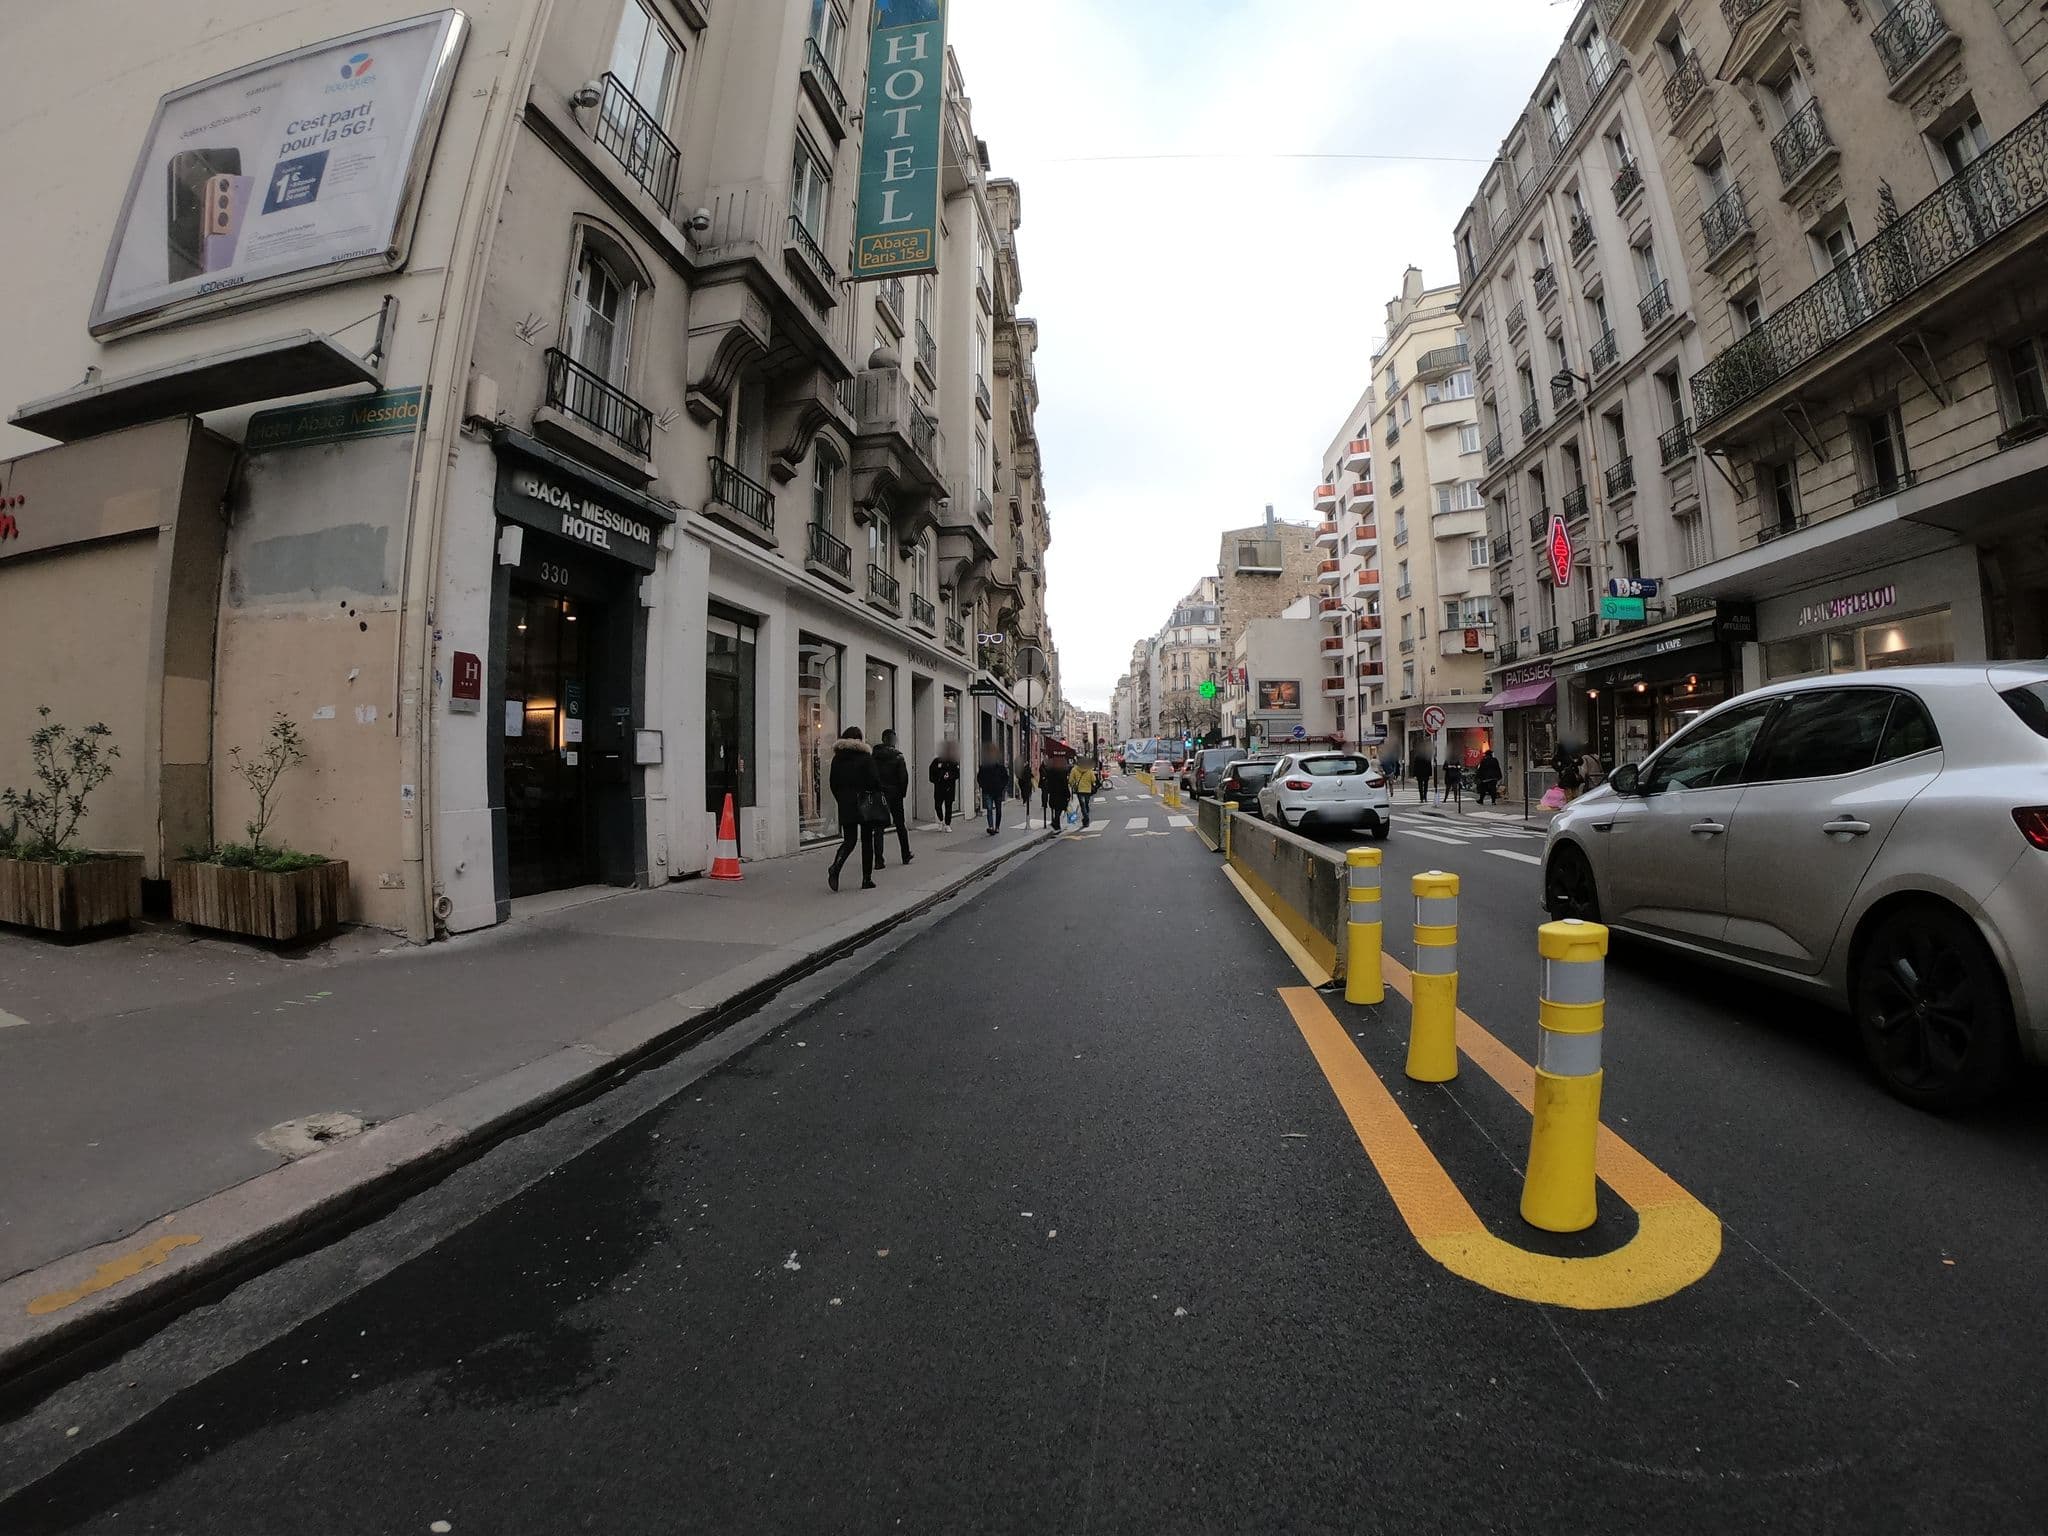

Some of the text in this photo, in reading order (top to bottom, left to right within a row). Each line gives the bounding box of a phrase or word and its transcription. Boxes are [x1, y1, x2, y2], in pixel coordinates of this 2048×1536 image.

[286, 113, 328, 135] C'est
[328, 100, 374, 128] parti
[879, 31, 930, 225] HOTEL
[279, 133, 321, 159] pour
[322, 129, 337, 143] la
[331, 247, 378, 261] summum
[871, 236, 919, 252] Abaca
[862, 247, 924, 265] Paris 15e
[197, 275, 245, 294] JCDecaux
[561, 514, 611, 550] HOTEL
[1554, 523, 1569, 577] TABAC
[540, 561, 569, 586] 330
[1656, 642, 1665, 653] LA
[465, 662, 479, 680] H
